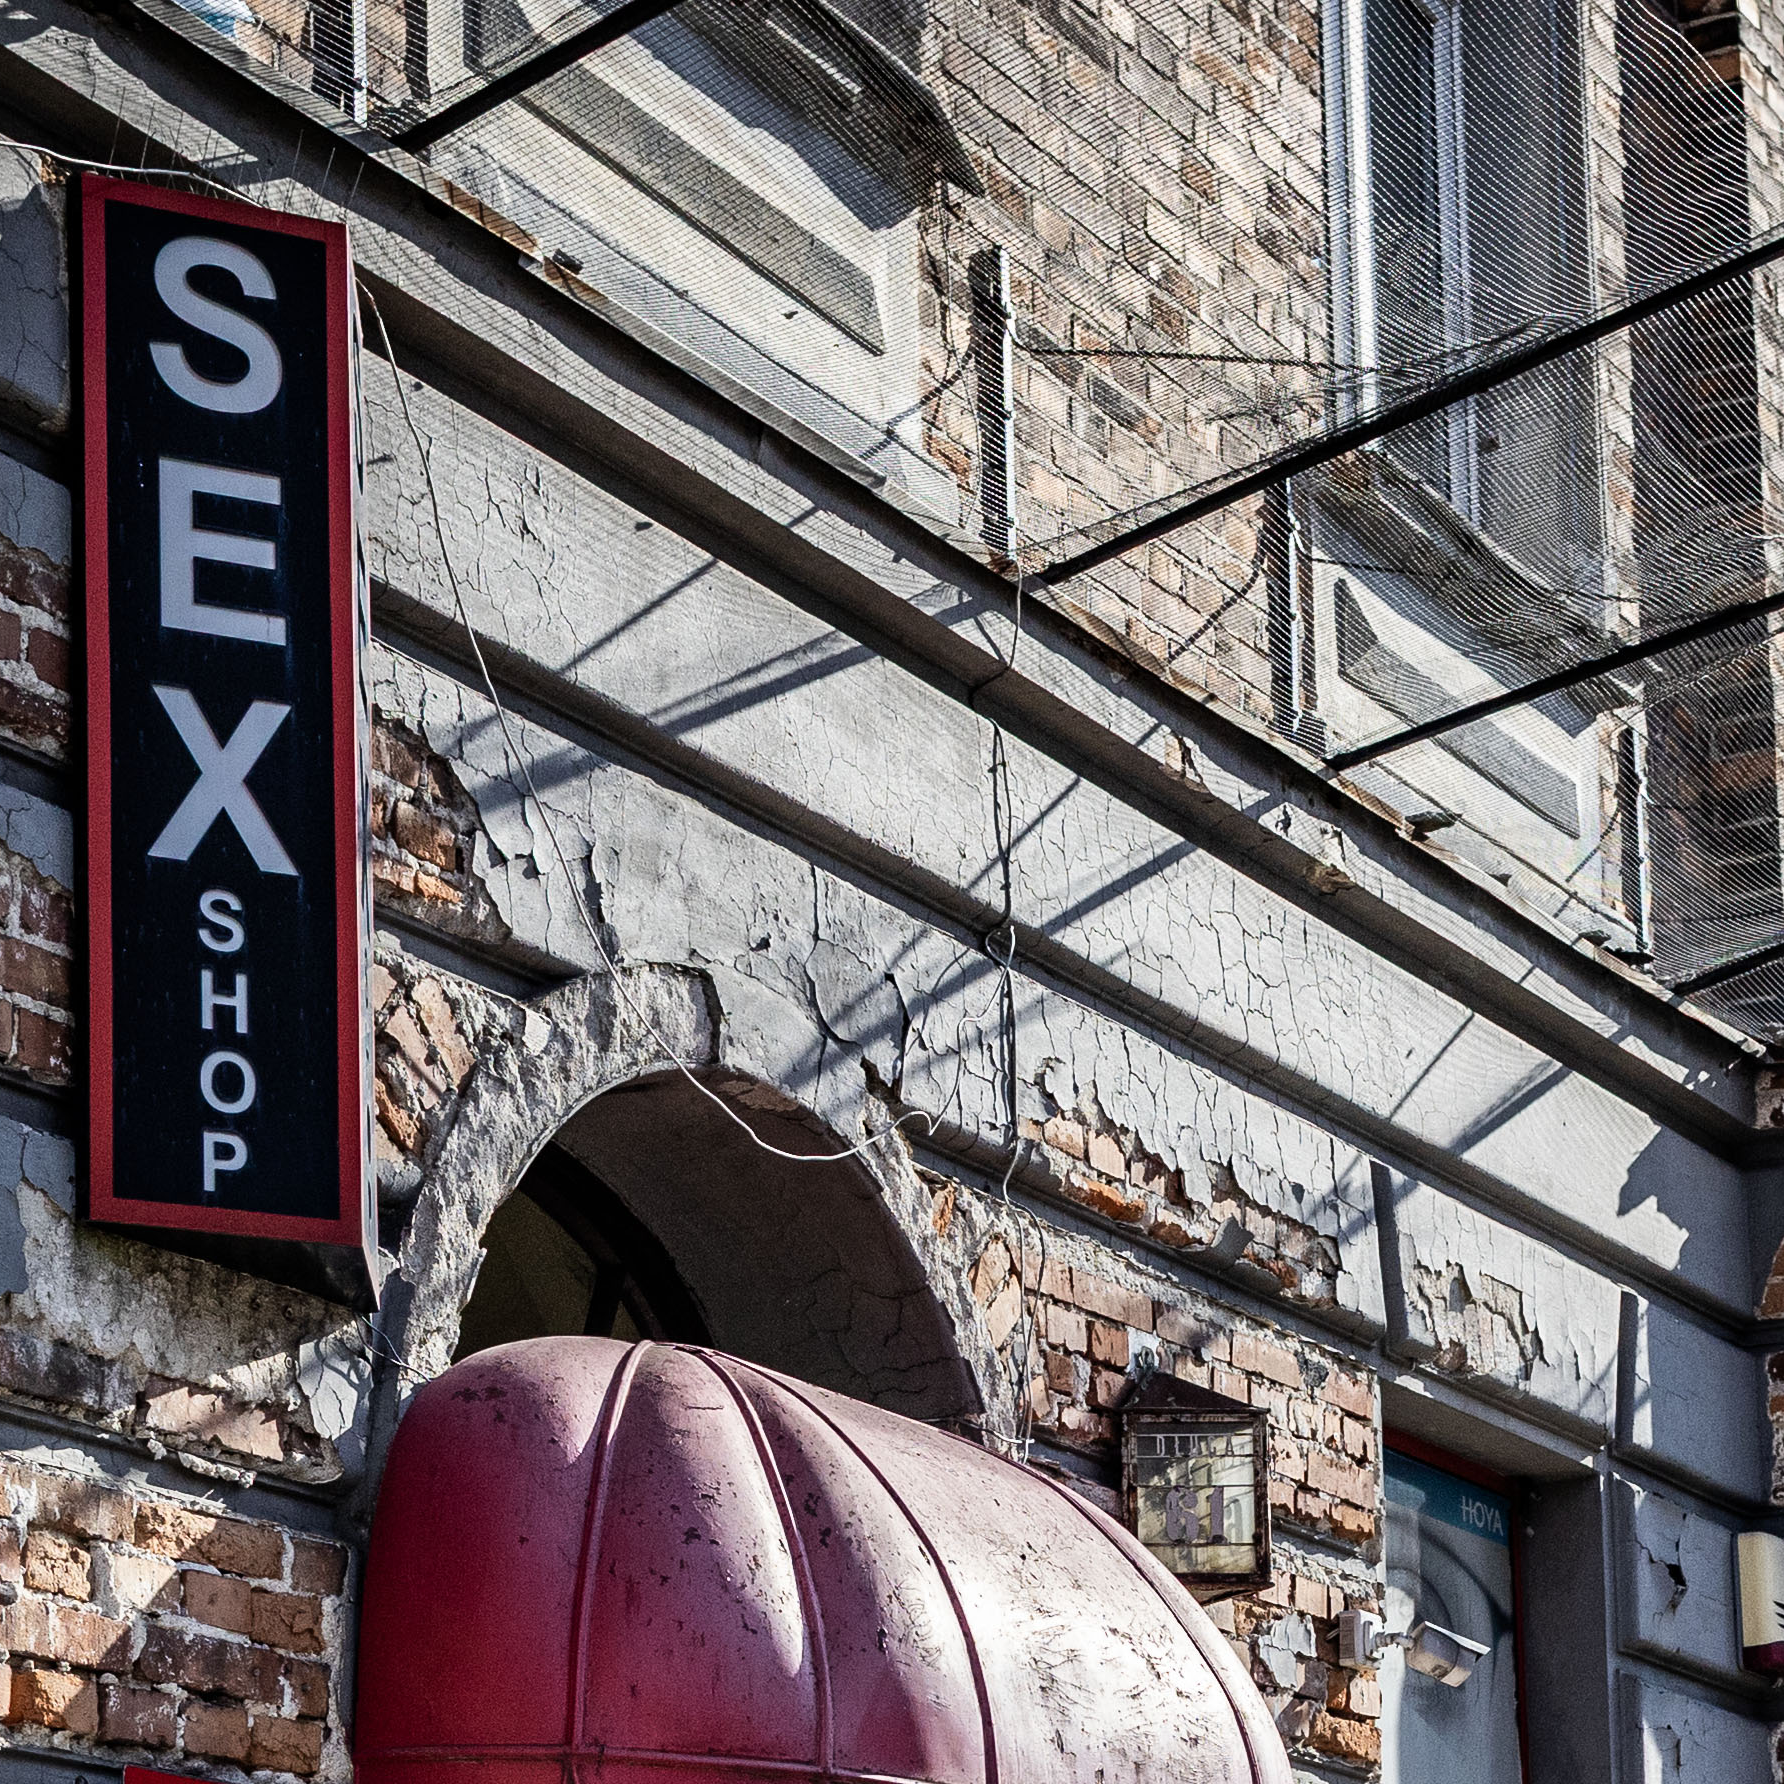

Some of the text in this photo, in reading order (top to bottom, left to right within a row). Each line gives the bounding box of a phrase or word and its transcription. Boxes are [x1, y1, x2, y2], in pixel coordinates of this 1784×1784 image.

[147, 236, 299, 1192] SEX SHOP
[1460, 1495, 1504, 1537] HOYA
